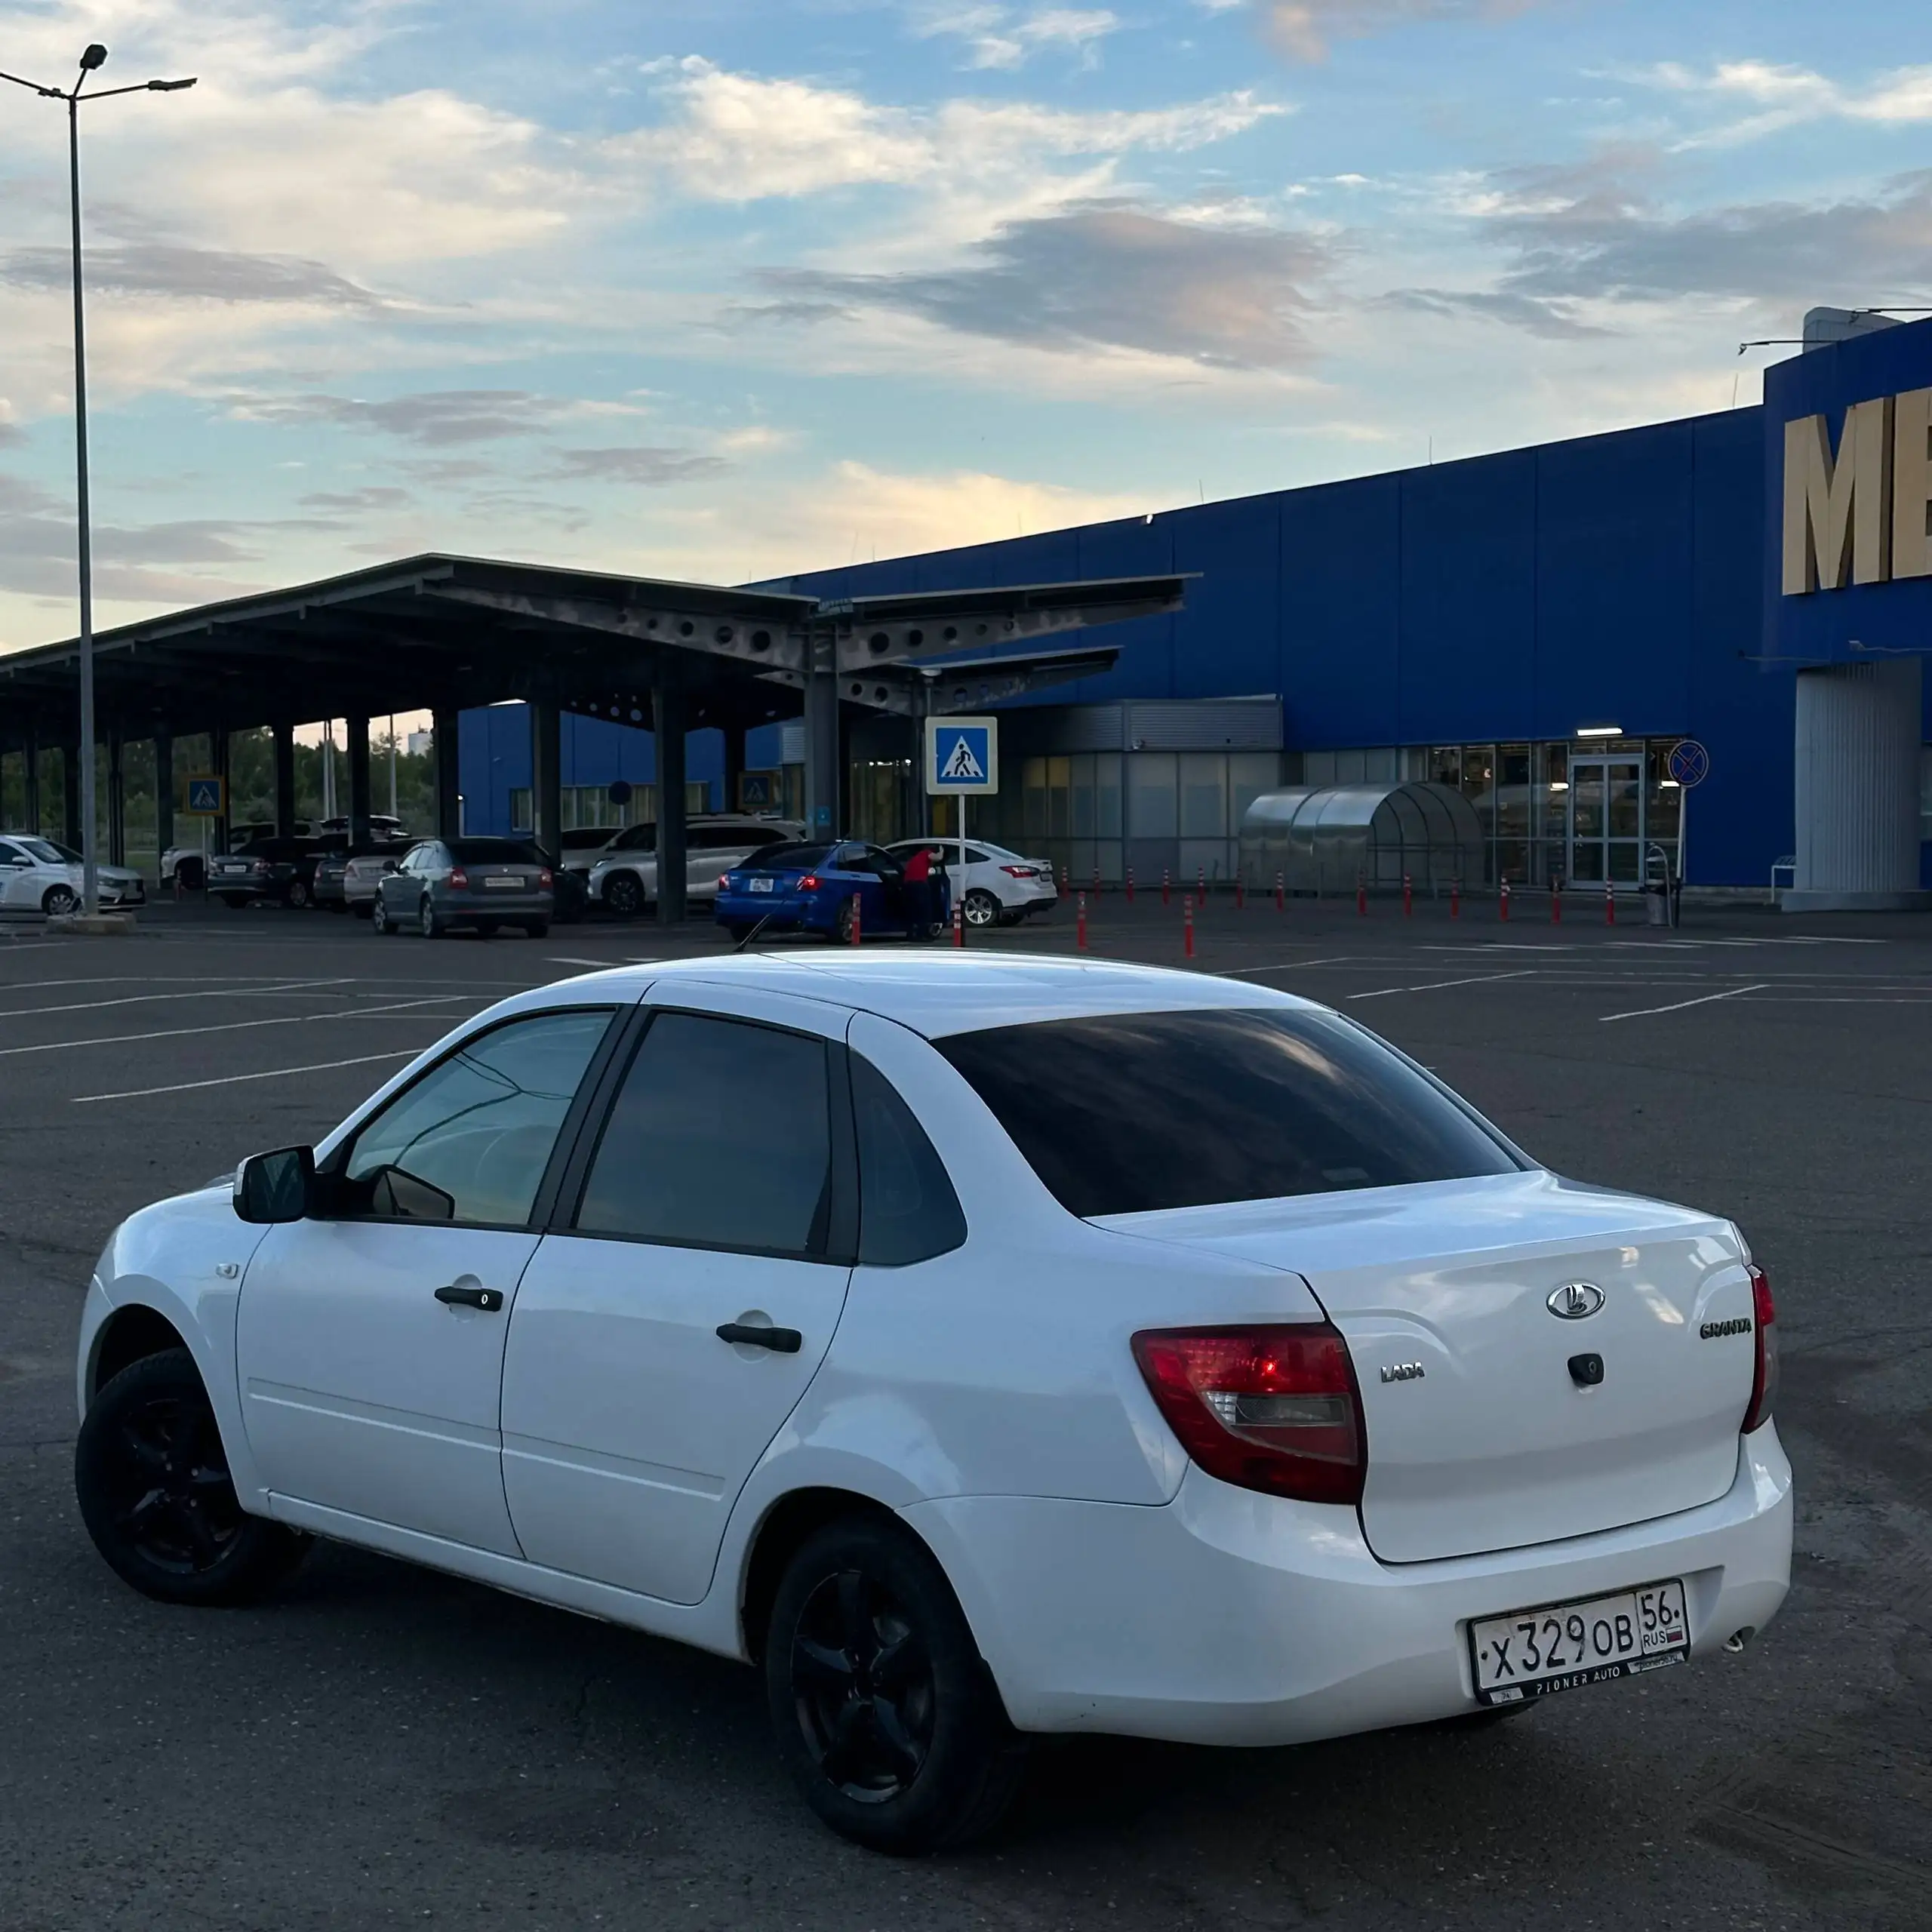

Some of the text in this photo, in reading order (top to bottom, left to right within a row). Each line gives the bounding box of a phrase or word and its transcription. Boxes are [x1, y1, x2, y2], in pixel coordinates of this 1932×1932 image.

[1700, 1318, 1752, 1340] GRANTA
[1380, 1361, 1426, 1383] LADA
[1641, 1591, 1673, 1630] 56
[1643, 1632, 1666, 1647] RUS
[1537, 1666, 1620, 1695] PIONER AUTO
